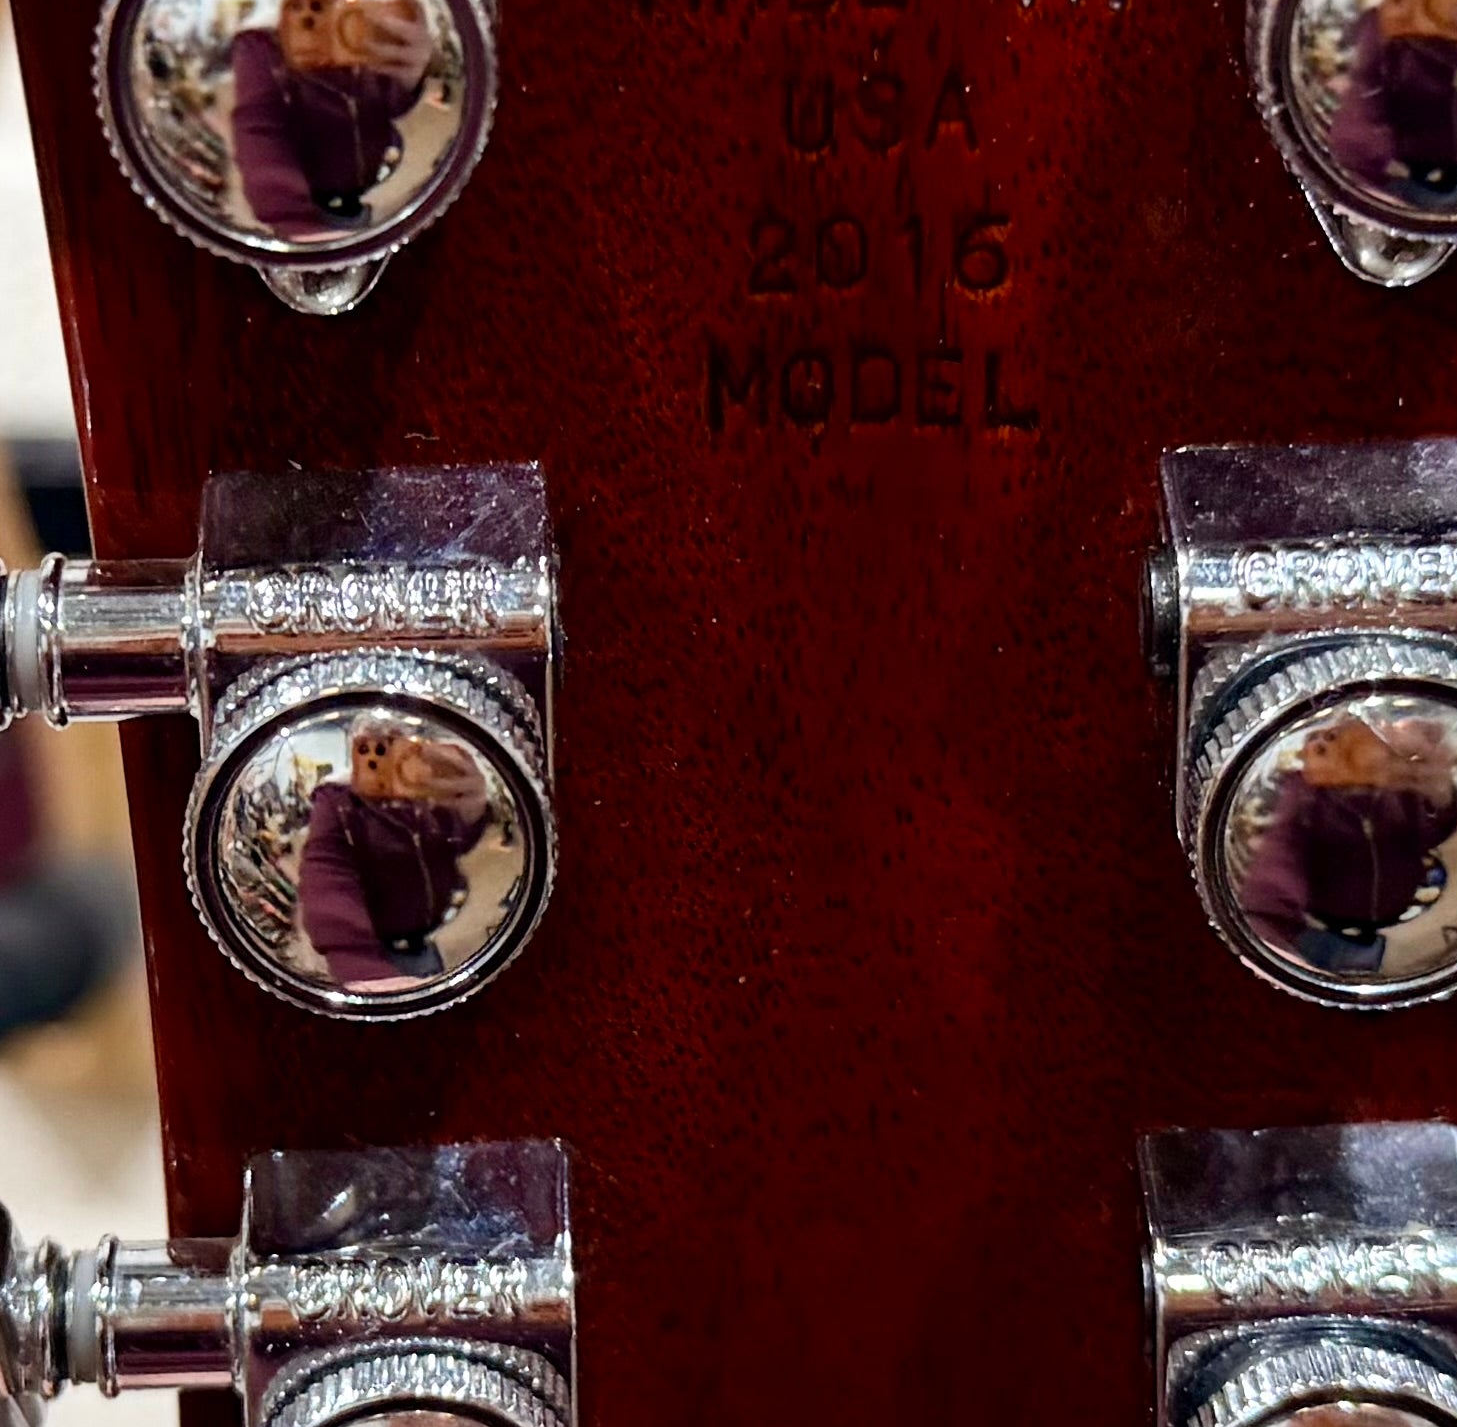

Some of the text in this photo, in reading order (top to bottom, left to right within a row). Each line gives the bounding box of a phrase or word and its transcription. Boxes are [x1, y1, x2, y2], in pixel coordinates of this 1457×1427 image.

[783, 67, 982, 156] USA
[746, 212, 1014, 301] 2016
[704, 340, 1042, 436] MODEL
